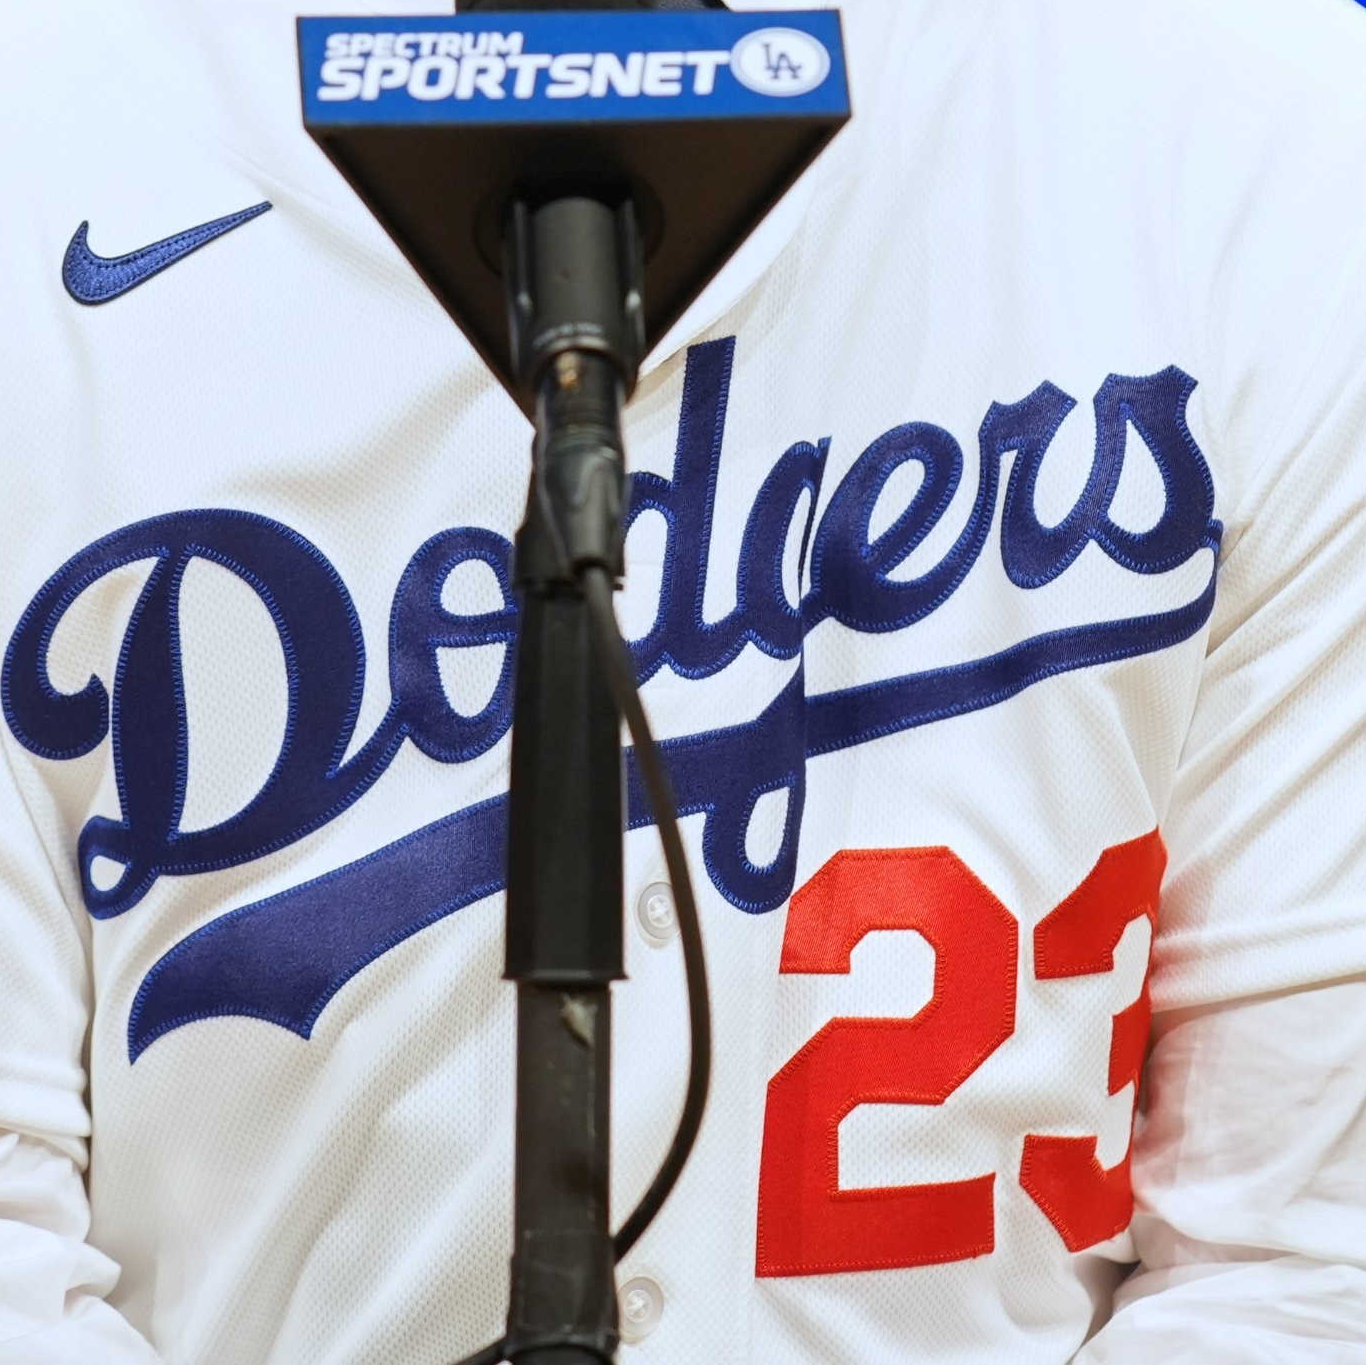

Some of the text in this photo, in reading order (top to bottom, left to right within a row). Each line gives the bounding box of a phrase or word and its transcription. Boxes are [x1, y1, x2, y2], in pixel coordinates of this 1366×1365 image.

[317, 42, 802, 101] SPORTSNET LA
[325, 31, 523, 57] SPECTRUM
[0, 334, 1217, 921] Dodgers
[754, 828, 1169, 1279] 23
